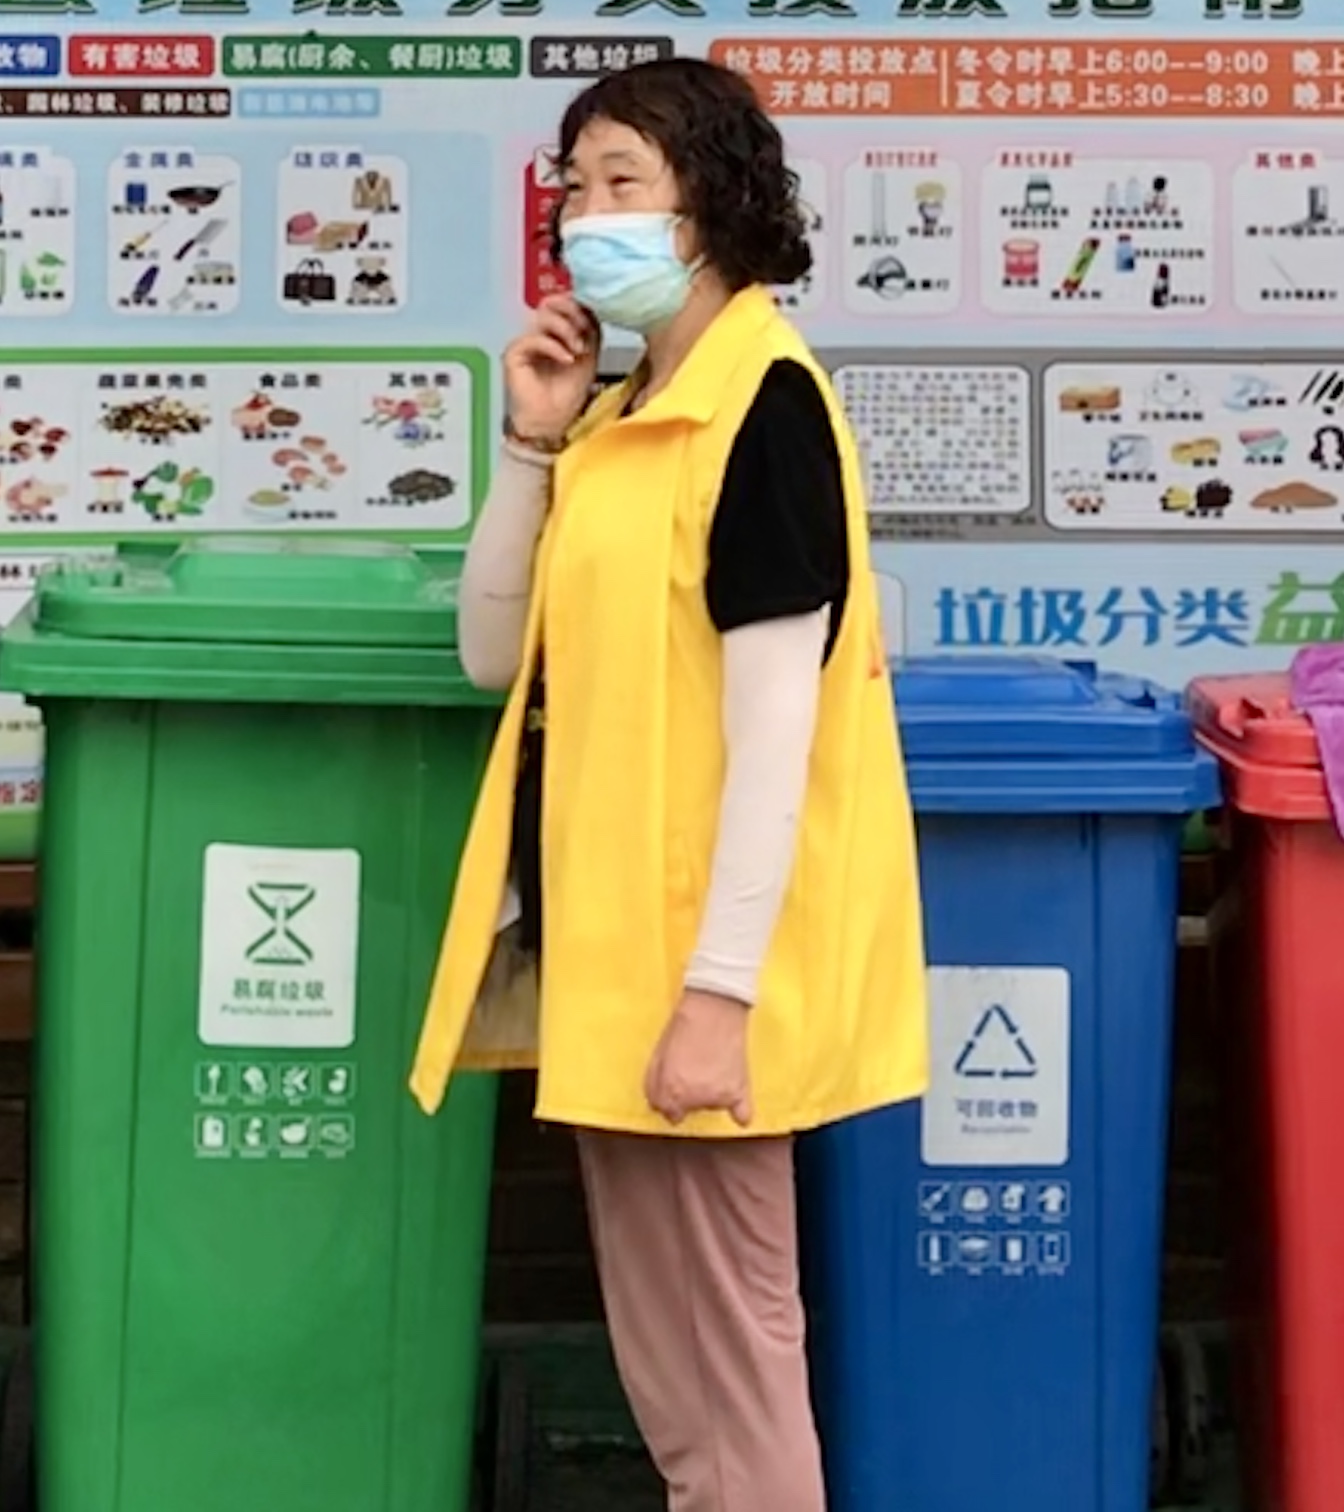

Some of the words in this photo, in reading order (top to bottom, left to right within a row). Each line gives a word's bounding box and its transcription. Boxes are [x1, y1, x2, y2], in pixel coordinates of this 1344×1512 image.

[81, 42, 201, 71] 有害垃圾
[541, 42, 659, 71] 其他垃圾
[724, 46, 937, 78] 垃圾分类投放点
[770, 79, 892, 109] 开放时间
[233, 977, 326, 1002] 易腐垃圾
[956, 1098, 1039, 1119] 可回收物
